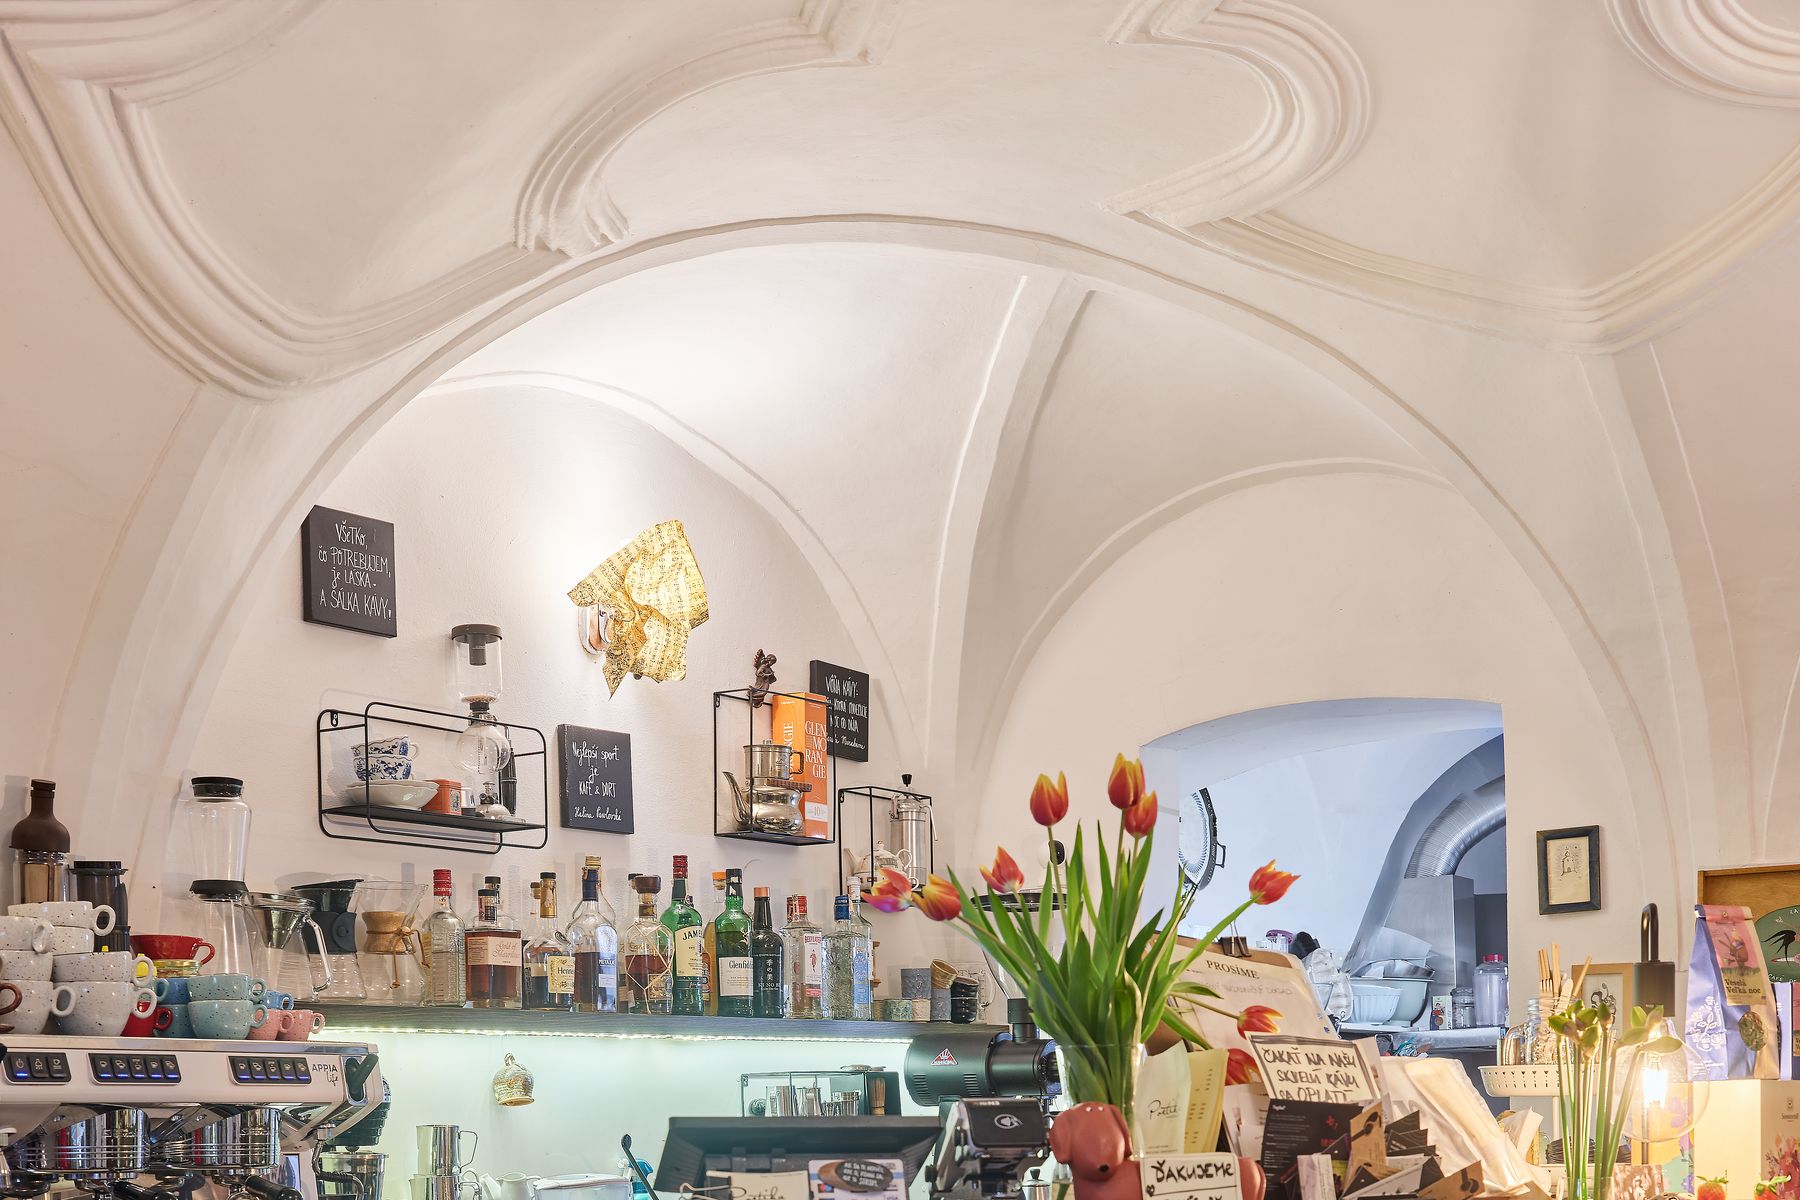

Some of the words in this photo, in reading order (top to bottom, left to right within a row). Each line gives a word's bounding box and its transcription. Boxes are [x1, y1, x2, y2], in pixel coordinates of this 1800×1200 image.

[319, 588, 327, 607] A
[805, 720, 827, 738] GLEN
[812, 736, 828, 751] MO
[805, 750, 823, 765] RAN
[812, 765, 827, 779] GIE
[1748, 987, 1761, 995] noc
[1304, 1052, 1327, 1066] NA
[311, 1062, 339, 1075] APPIA
[326, 1071, 340, 1086] life
